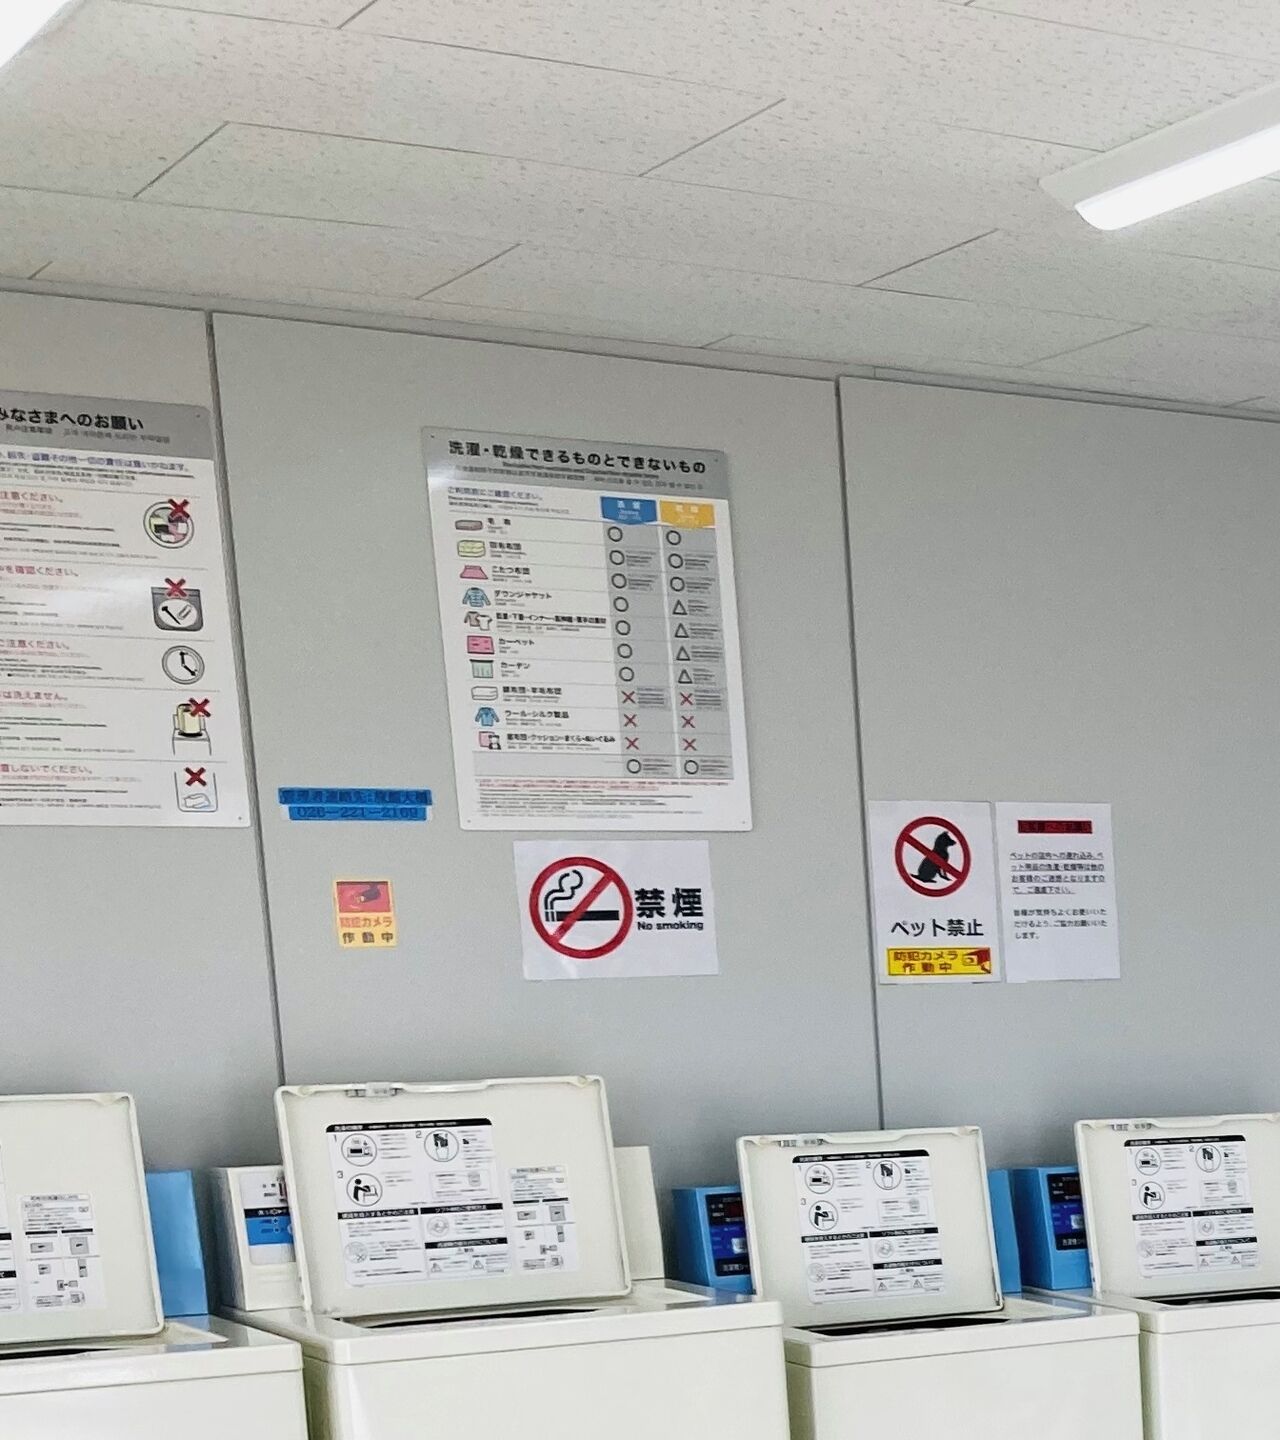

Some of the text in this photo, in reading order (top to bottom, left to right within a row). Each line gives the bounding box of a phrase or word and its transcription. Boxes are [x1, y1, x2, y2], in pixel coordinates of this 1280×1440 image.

[448, 441, 706, 474] 洗濯・乾燥できるものとできないもの
[635, 888, 704, 918] 禁煙
[638, 921, 704, 931] No smoking
[890, 918, 984, 937] ペット禁止
[894, 951, 958, 961] 防犯カメラ
[902, 962, 952, 973] 作動中
